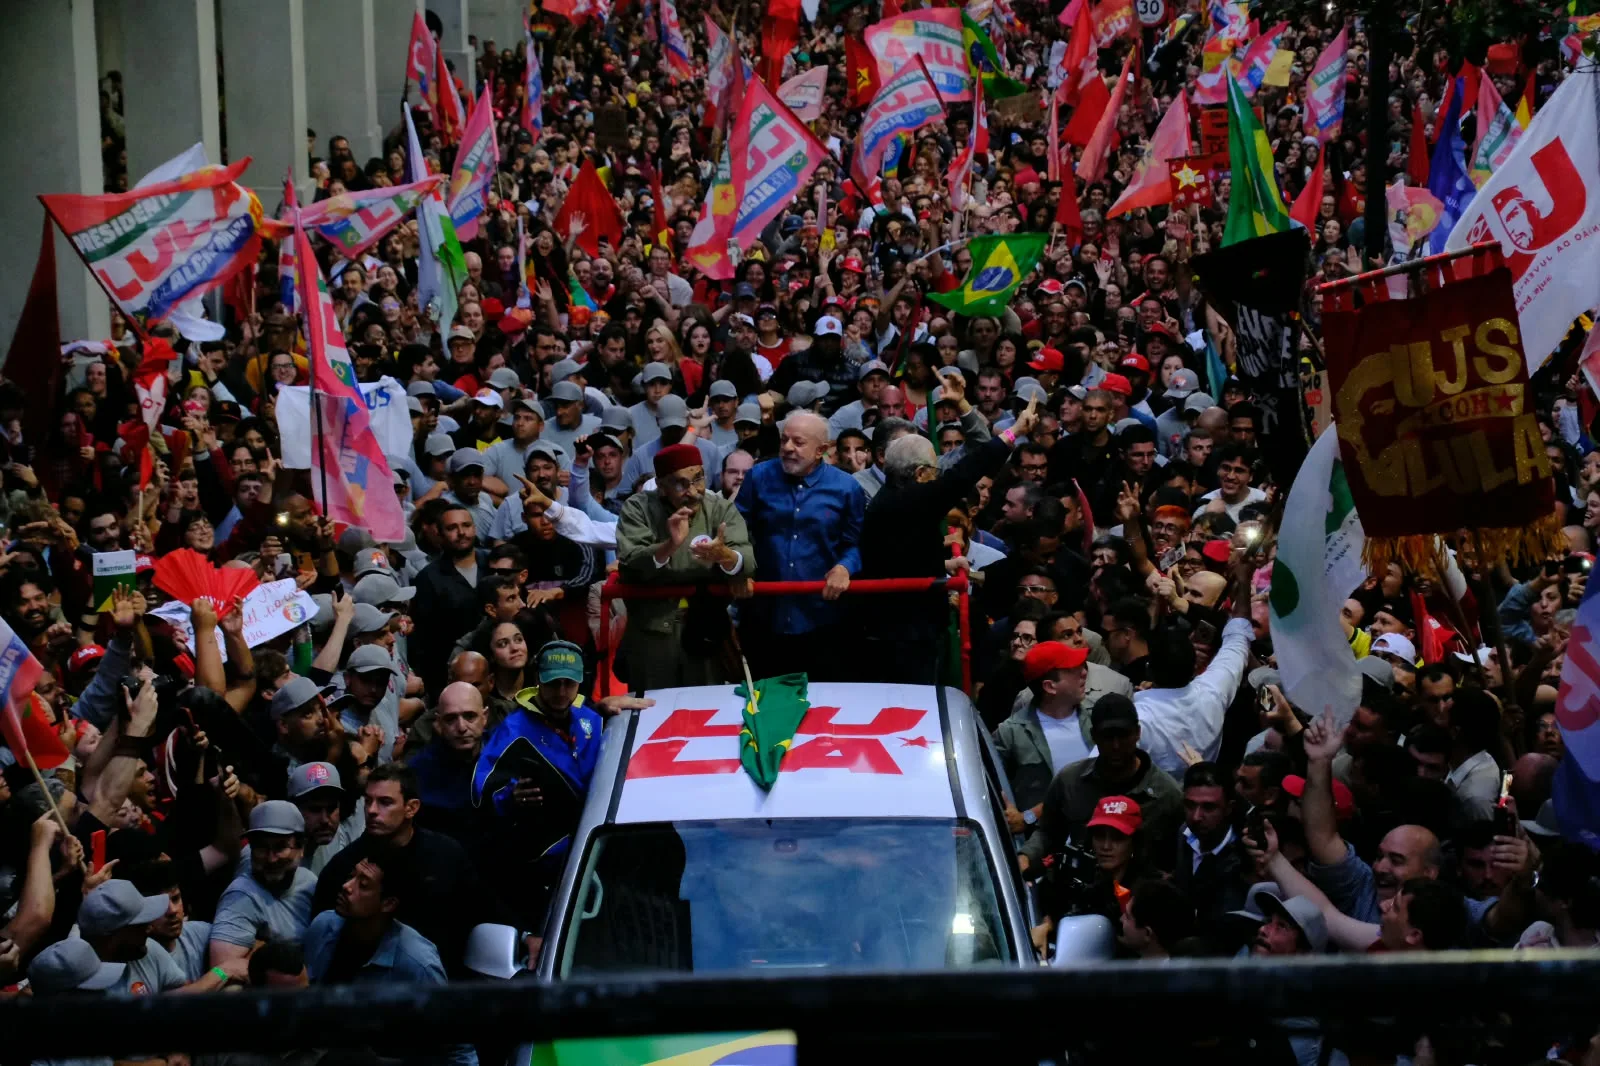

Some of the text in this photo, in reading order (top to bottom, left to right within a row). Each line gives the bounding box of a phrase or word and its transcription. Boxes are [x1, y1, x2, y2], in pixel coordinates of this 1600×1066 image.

[1139, 0, 1160, 15] 30
[170, 215, 249, 293] ALCKMIN
[1389, 317, 1522, 408] UJS
[1402, 412, 1552, 499] LULA
